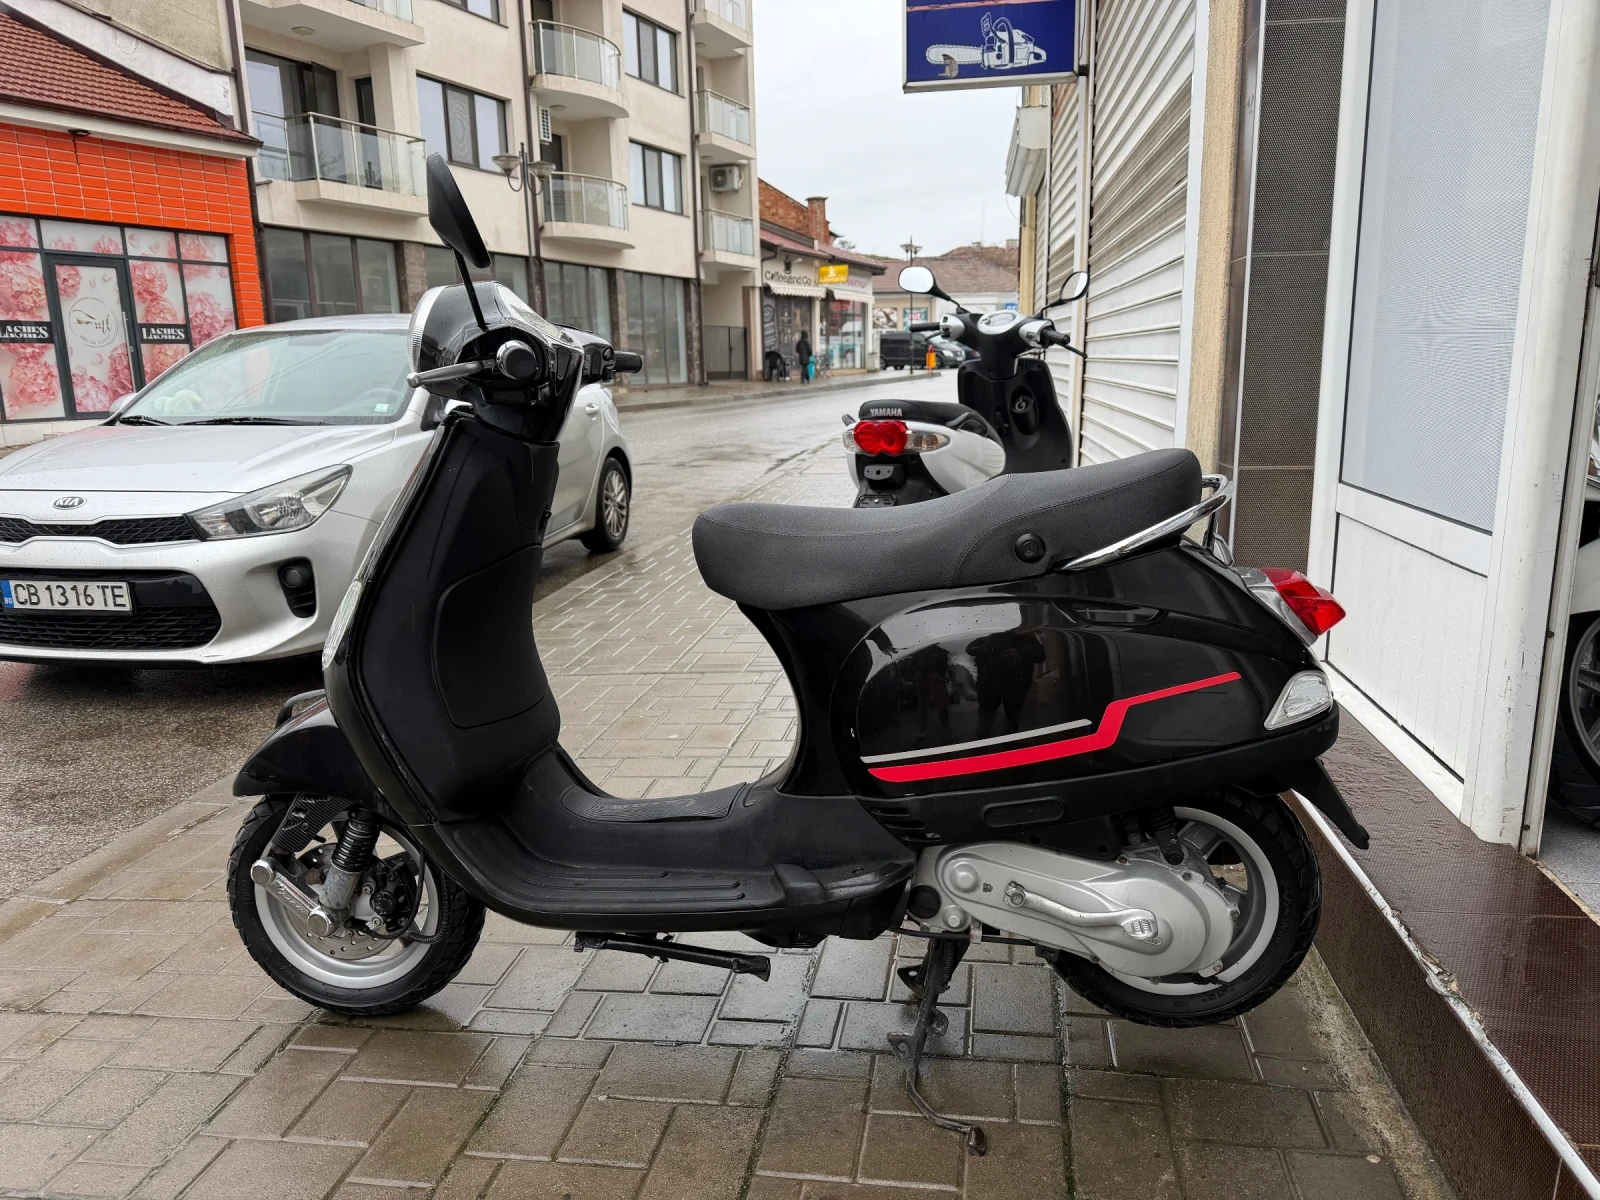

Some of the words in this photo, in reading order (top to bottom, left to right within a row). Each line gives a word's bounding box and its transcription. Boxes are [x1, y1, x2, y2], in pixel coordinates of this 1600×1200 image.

[142, 327, 185, 340] LASHES
[870, 408, 903, 417] YAMAHA
[55, 497, 80, 506] KIA
